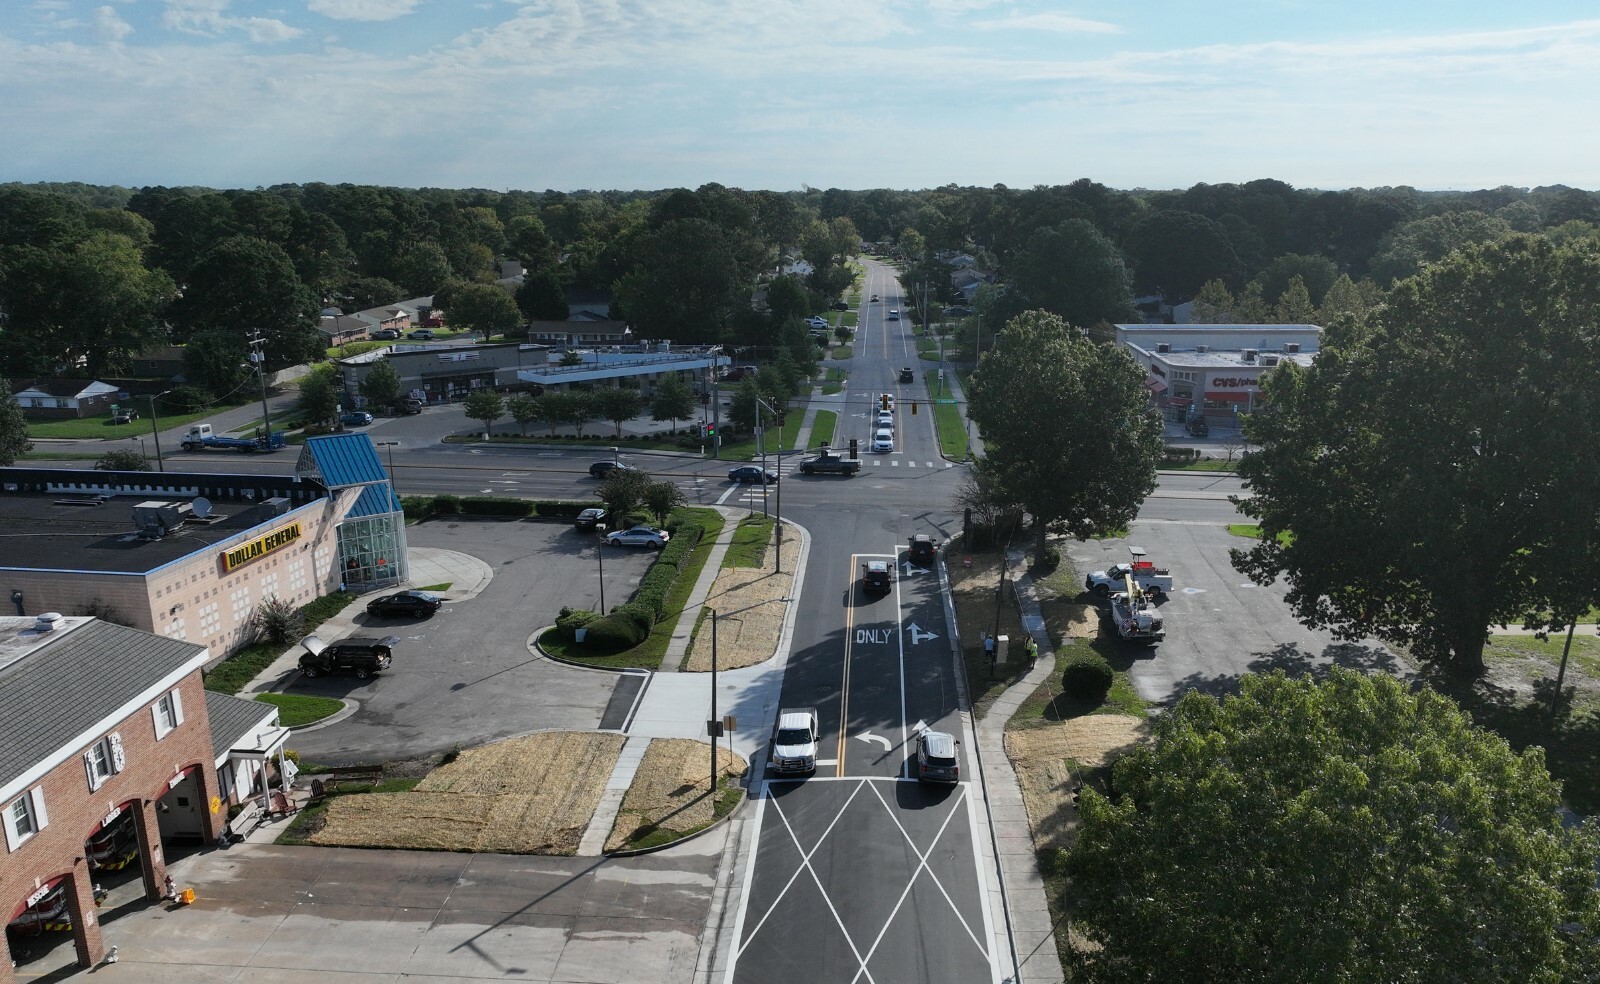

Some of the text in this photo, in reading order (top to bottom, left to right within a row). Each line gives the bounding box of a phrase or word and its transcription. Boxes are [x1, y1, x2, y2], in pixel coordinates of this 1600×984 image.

[1212, 377, 1258, 388] CVS/pha
[229, 524, 300, 567] DOLLAR GENERAL
[856, 629, 892, 644] ONLY
